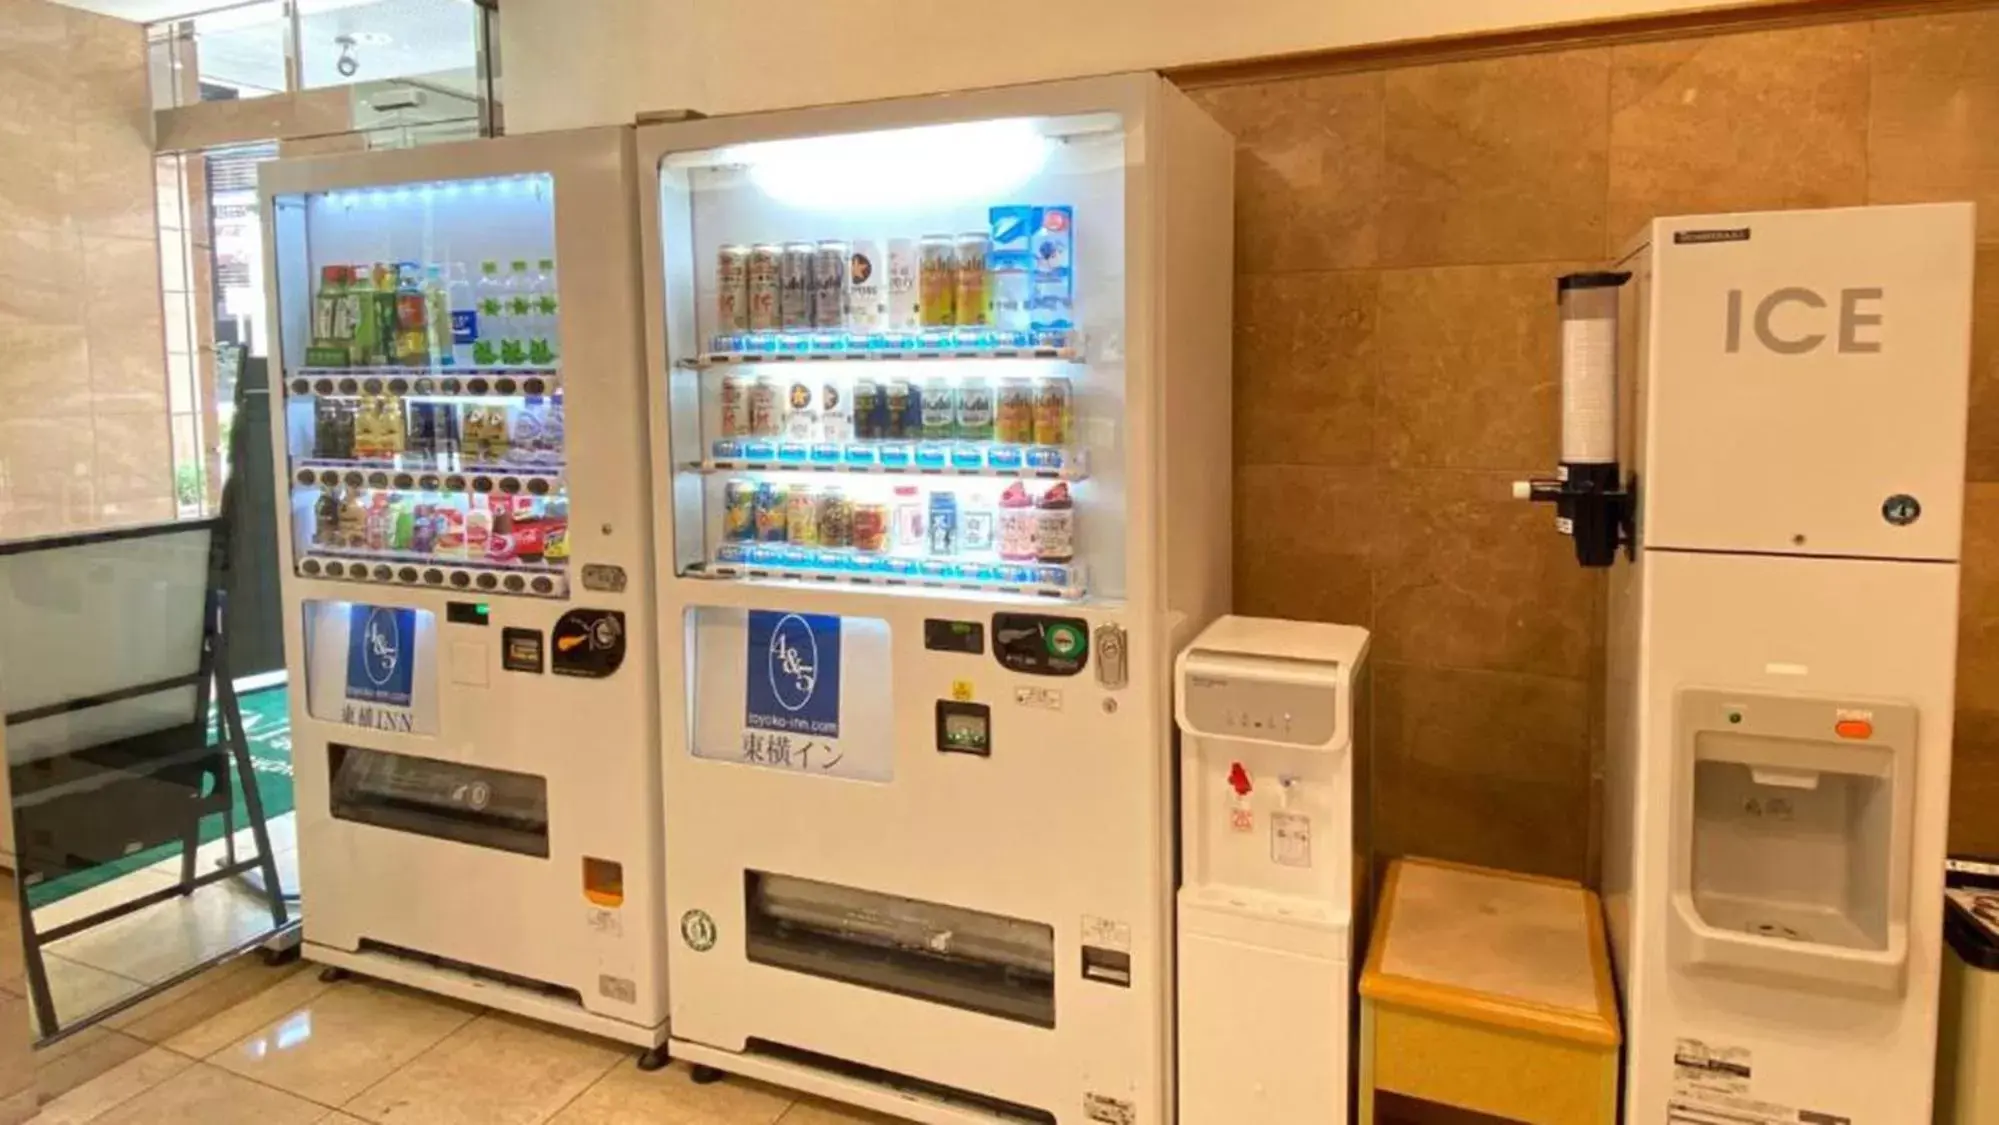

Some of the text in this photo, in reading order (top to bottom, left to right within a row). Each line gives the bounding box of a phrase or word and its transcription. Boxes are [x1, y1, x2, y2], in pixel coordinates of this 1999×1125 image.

[1724, 286, 1884, 354] ICE
[771, 633, 815, 692] 4&5
[742, 732, 844, 770] 東横イン
